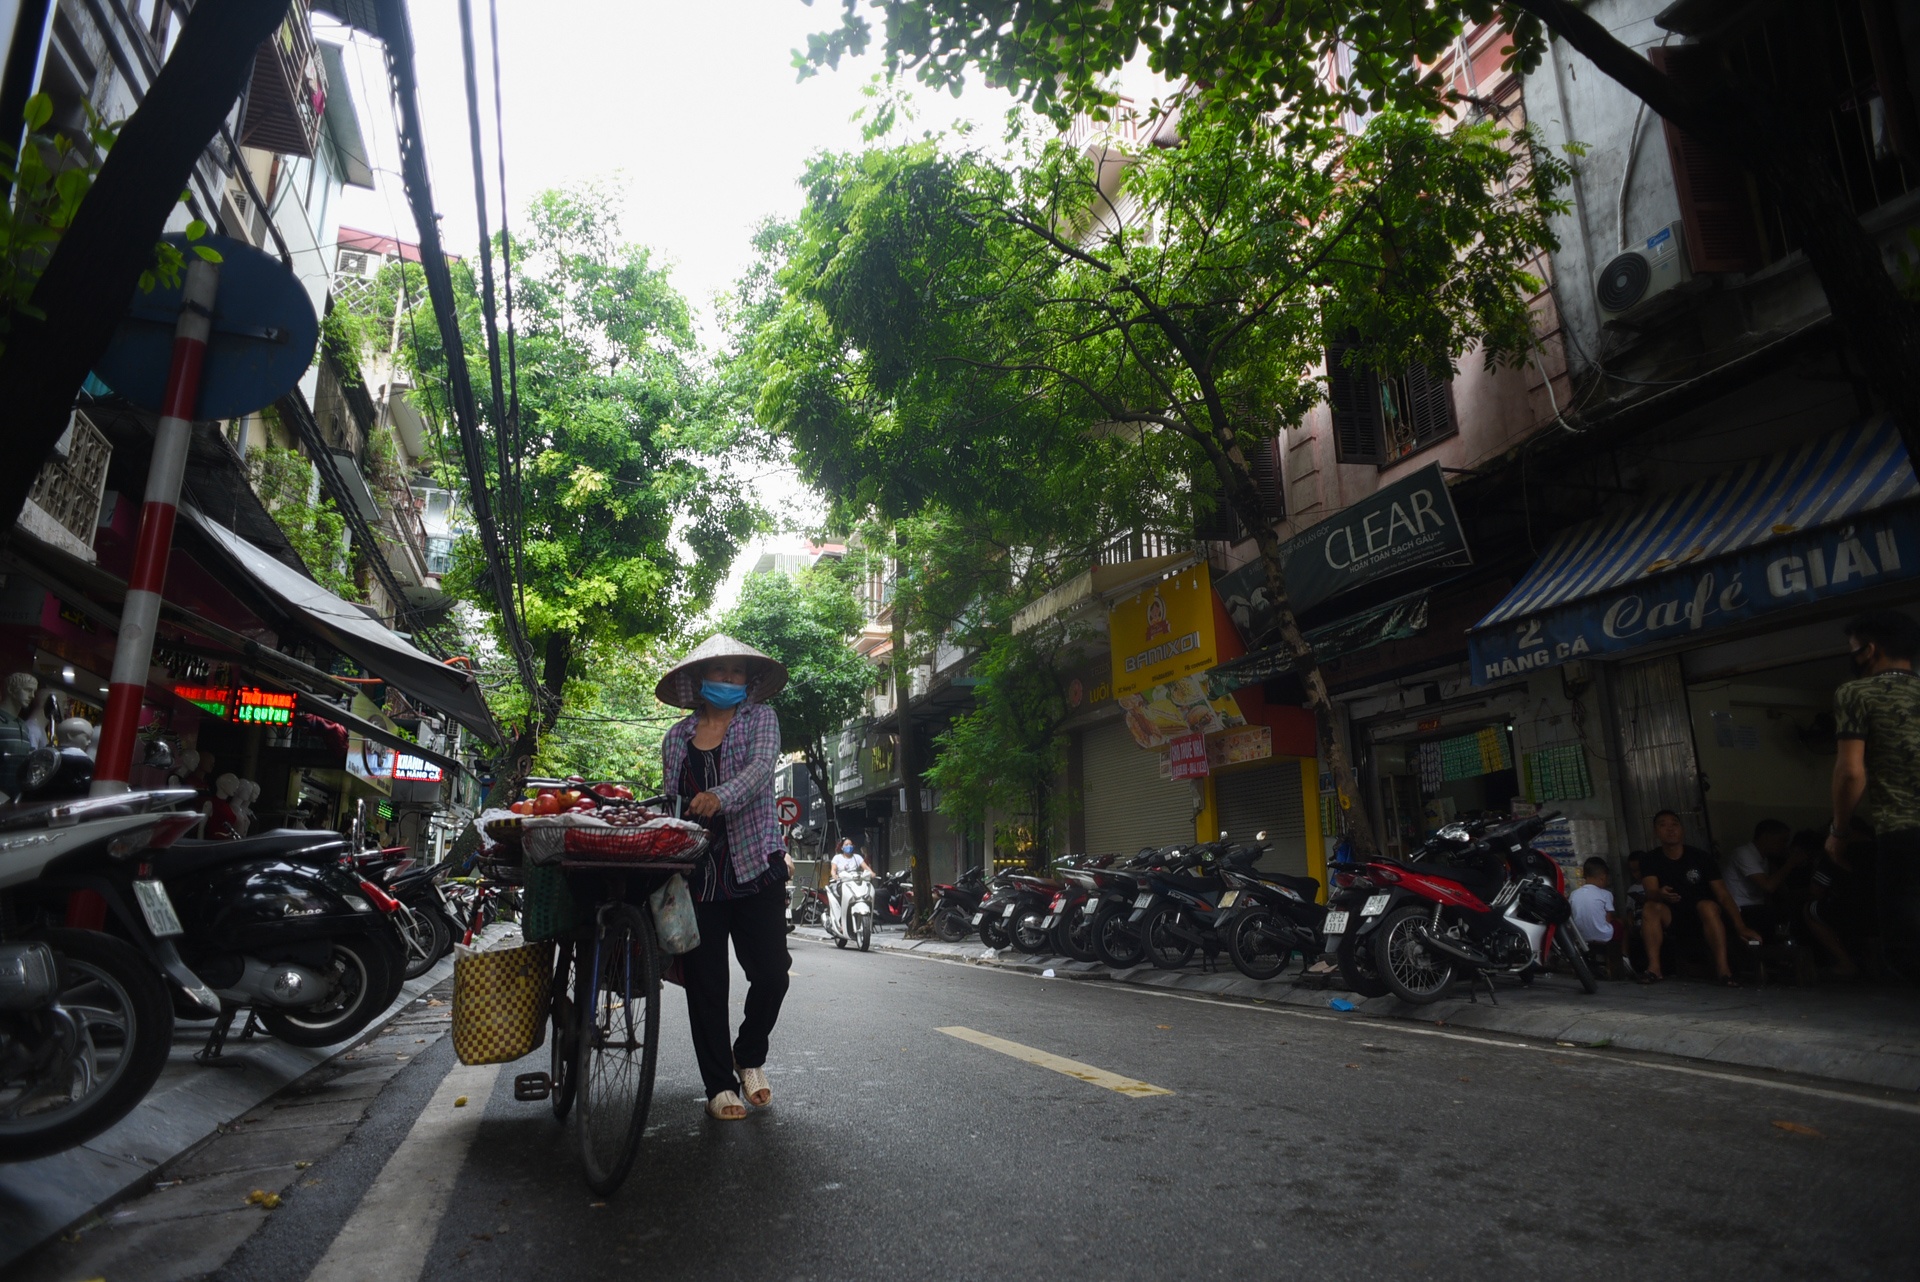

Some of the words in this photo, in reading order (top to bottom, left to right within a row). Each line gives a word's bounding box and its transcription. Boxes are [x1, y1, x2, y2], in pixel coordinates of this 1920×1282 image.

[1324, 488, 1445, 570] CLEAR
[1349, 561, 1369, 574] HOÀN
[1369, 549, 1390, 564] TOÀN
[1391, 540, 1414, 555] SẠCH
[1602, 572, 1750, 640] Café
[1766, 525, 1901, 599] GIẢI
[1516, 618, 1544, 650] 2
[1485, 649, 1549, 679] HÀNG
[1555, 634, 1591, 660] CÁ
[239, 704, 253, 721] LỆ
[253, 706, 290, 723] QUỲNH
[262, 693, 292, 708] TRANG
[283, 903, 325, 917] Vespa
